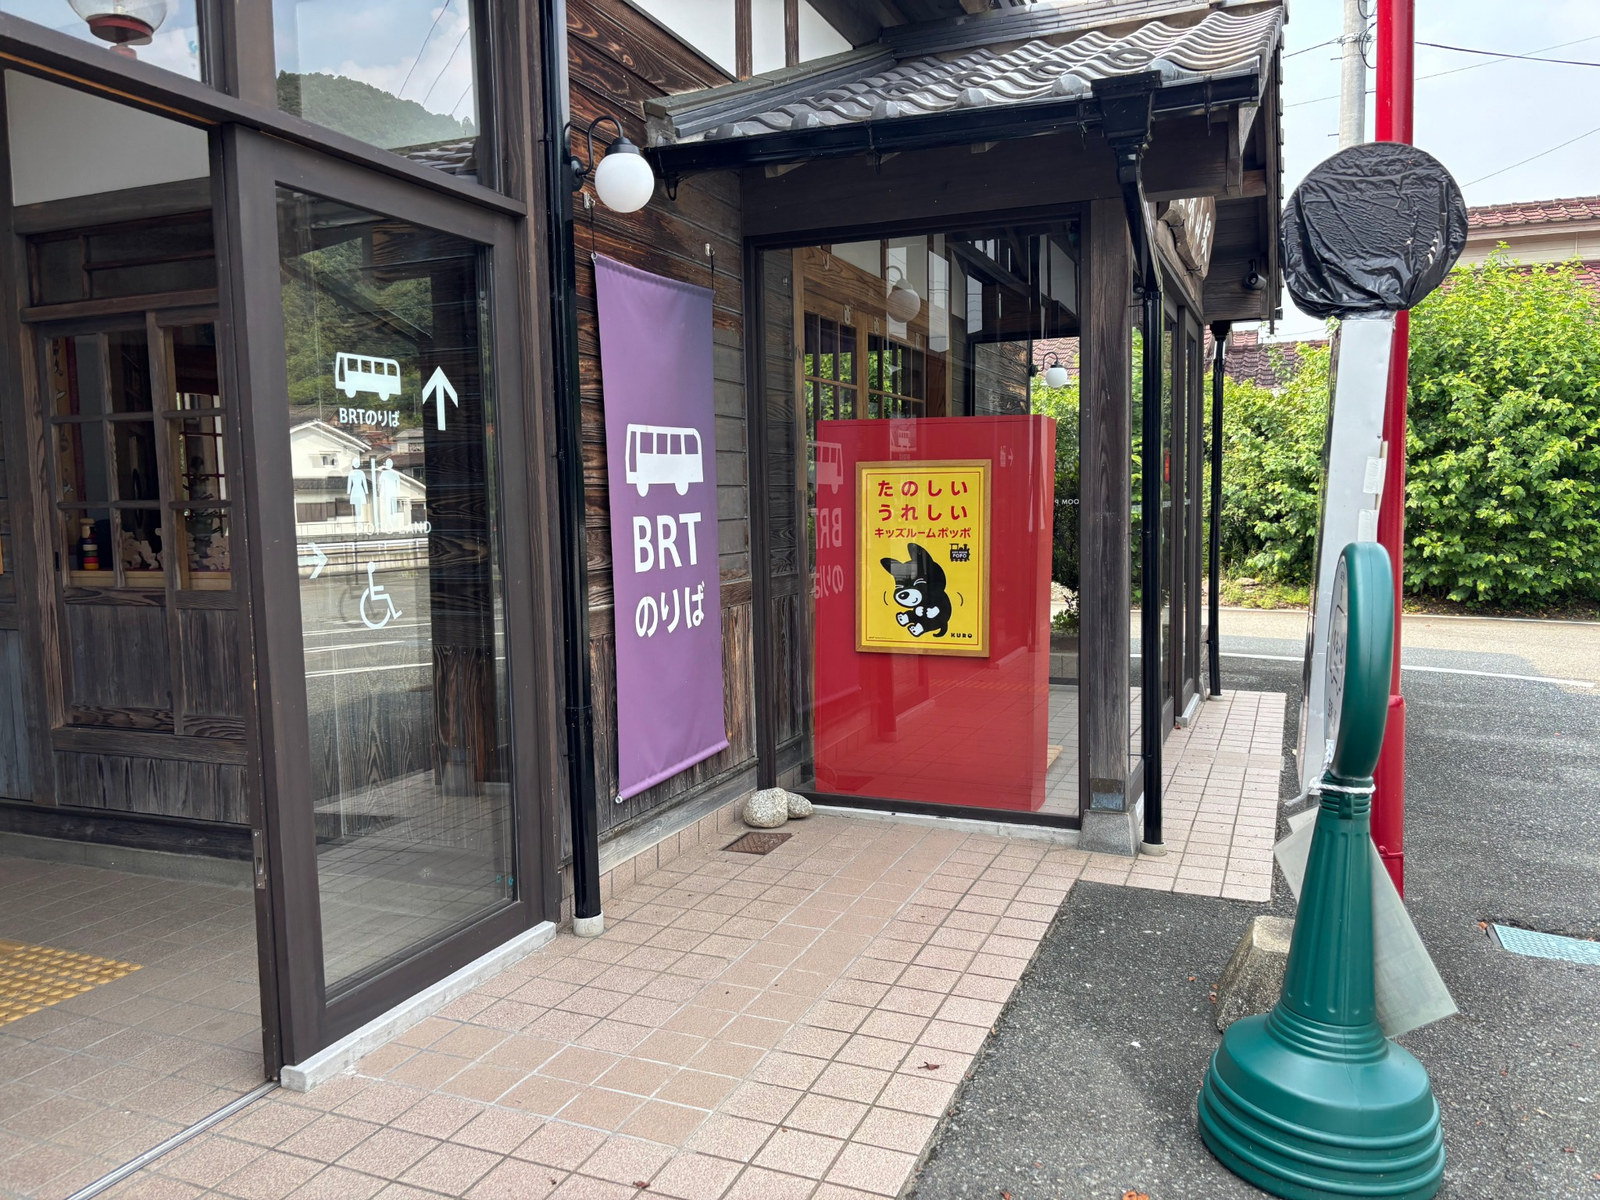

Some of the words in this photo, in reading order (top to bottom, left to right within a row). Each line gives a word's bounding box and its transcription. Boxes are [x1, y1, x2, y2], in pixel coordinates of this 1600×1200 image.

[339, 407, 400, 428] BRTのりば
[877, 479, 968, 498] たのしい
[877, 503, 968, 522] うれしい
[398, 520, 432, 535] LAND
[874, 526, 972, 539] キッズルームポッポ
[632, 512, 702, 573] BRT
[635, 581, 705, 638] のりば
